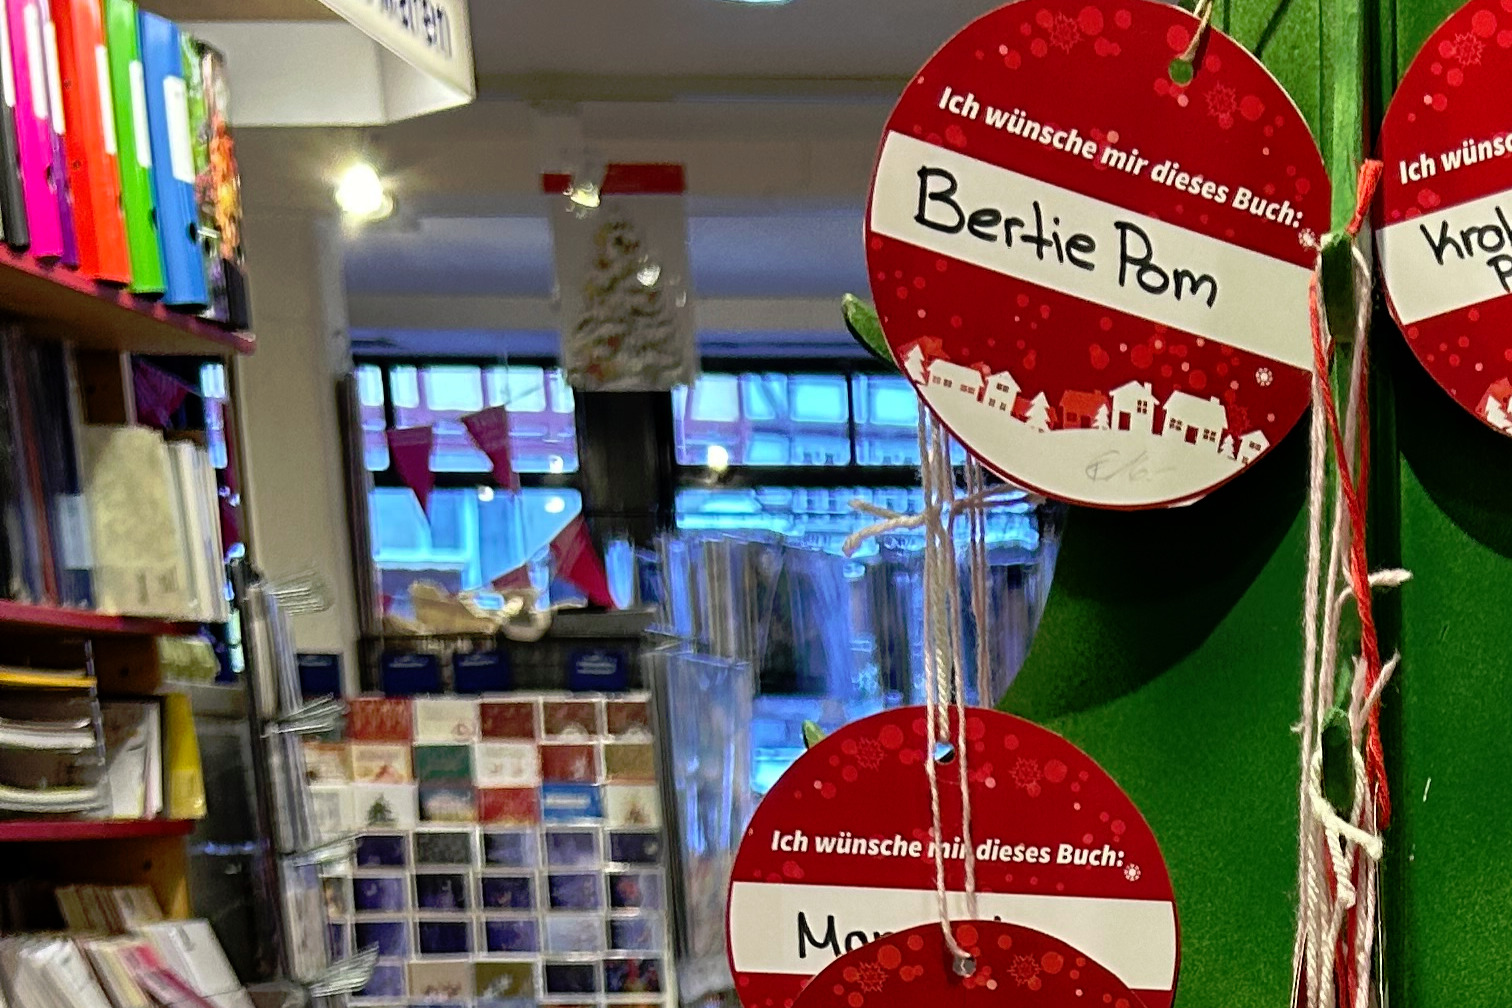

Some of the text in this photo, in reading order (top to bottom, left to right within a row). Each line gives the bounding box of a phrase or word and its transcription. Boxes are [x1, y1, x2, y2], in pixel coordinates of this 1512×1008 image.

[939, 86, 1304, 229] Ich wünsche mir dieses Buch:
[1399, 158, 1436, 184] Ich
[914, 165, 1217, 308] Bertie Pom
[772, 830, 808, 852] Ich
[815, 832, 922, 857] wünsche
[976, 840, 1051, 864] dieses
[1056, 844, 1124, 868] Buch:
